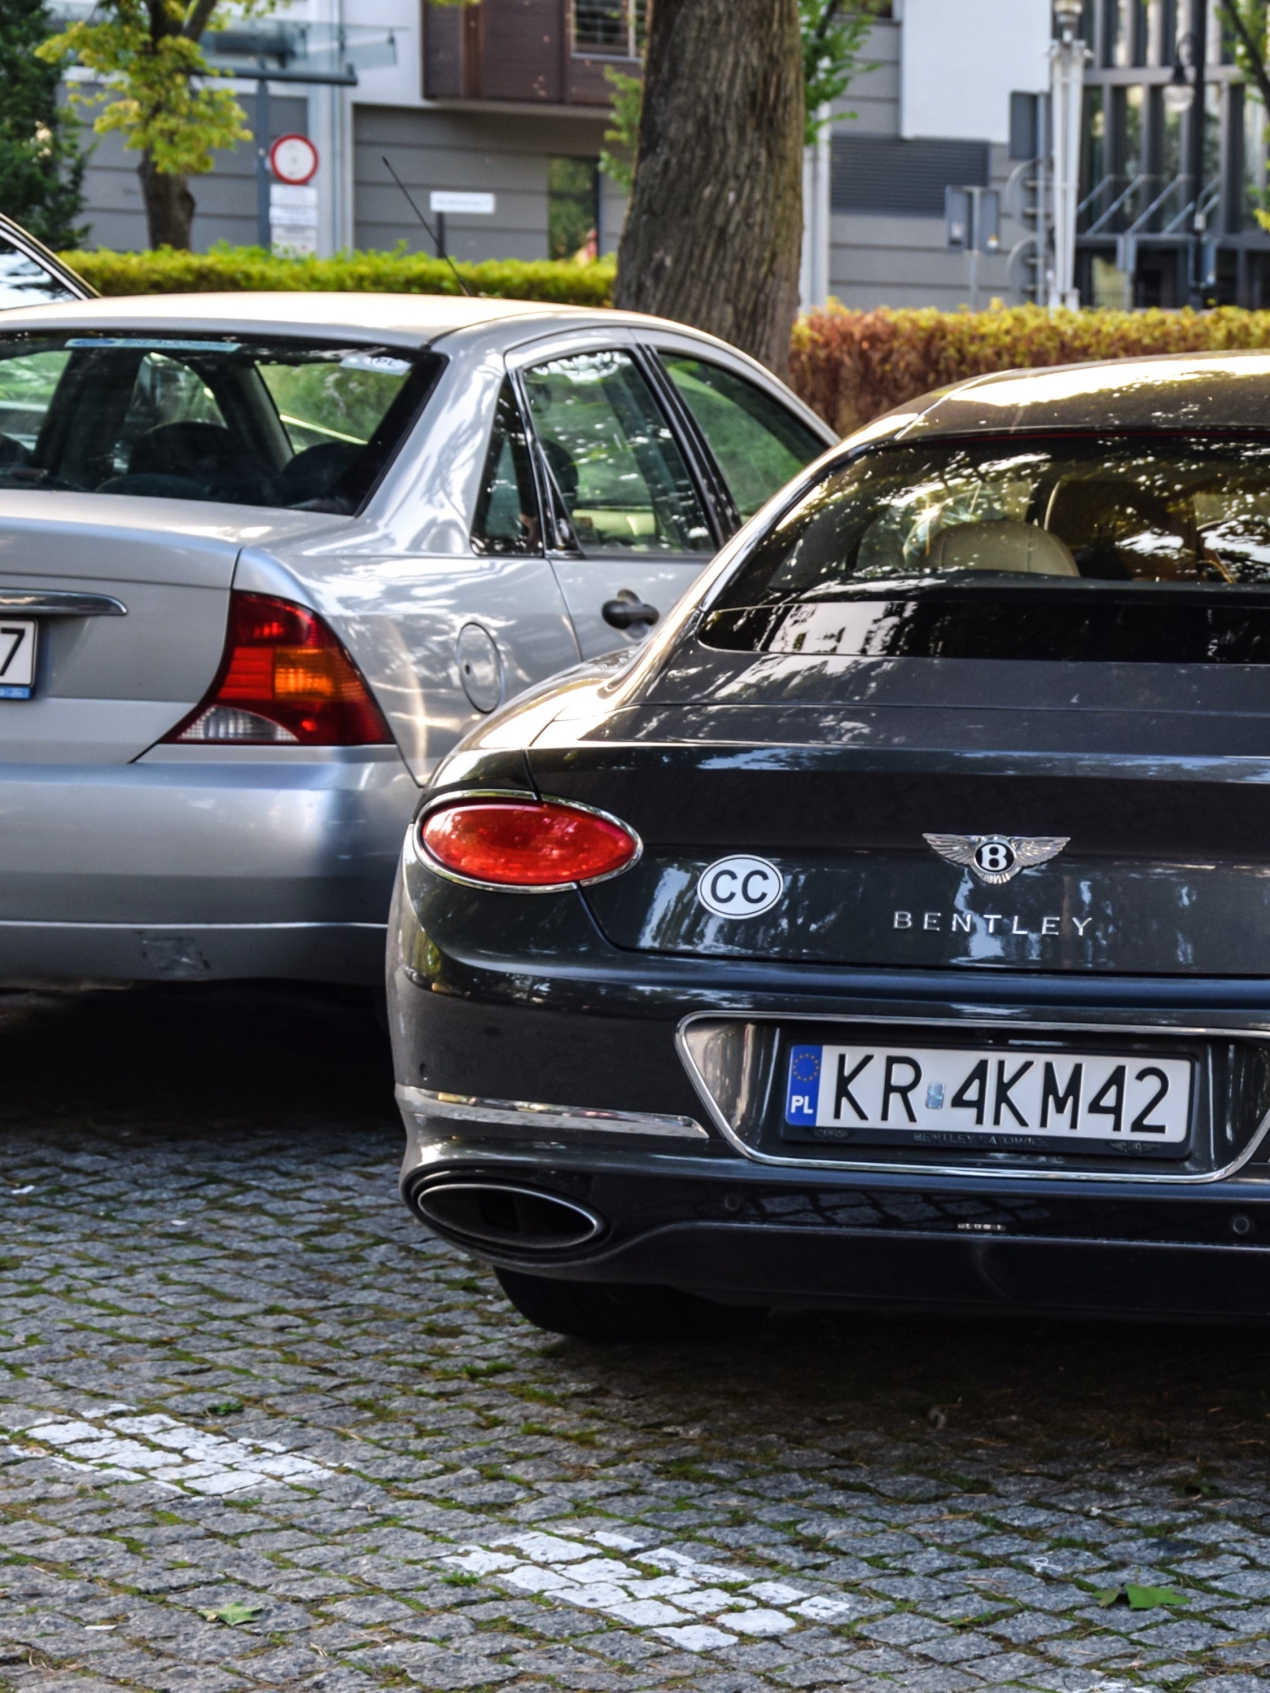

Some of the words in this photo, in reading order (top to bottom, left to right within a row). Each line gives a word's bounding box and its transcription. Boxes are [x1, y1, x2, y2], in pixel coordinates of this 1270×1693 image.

[0, 627, 25, 676] 7
[981, 844, 1007, 871] B
[711, 869, 769, 904] CC
[893, 911, 1093, 937] BENTLEY
[791, 1095, 814, 1114] PL
[833, 1053, 922, 1123] KR
[951, 1059, 1169, 1134] 4KM42
[913, 1132, 974, 1145] BENTLEY
